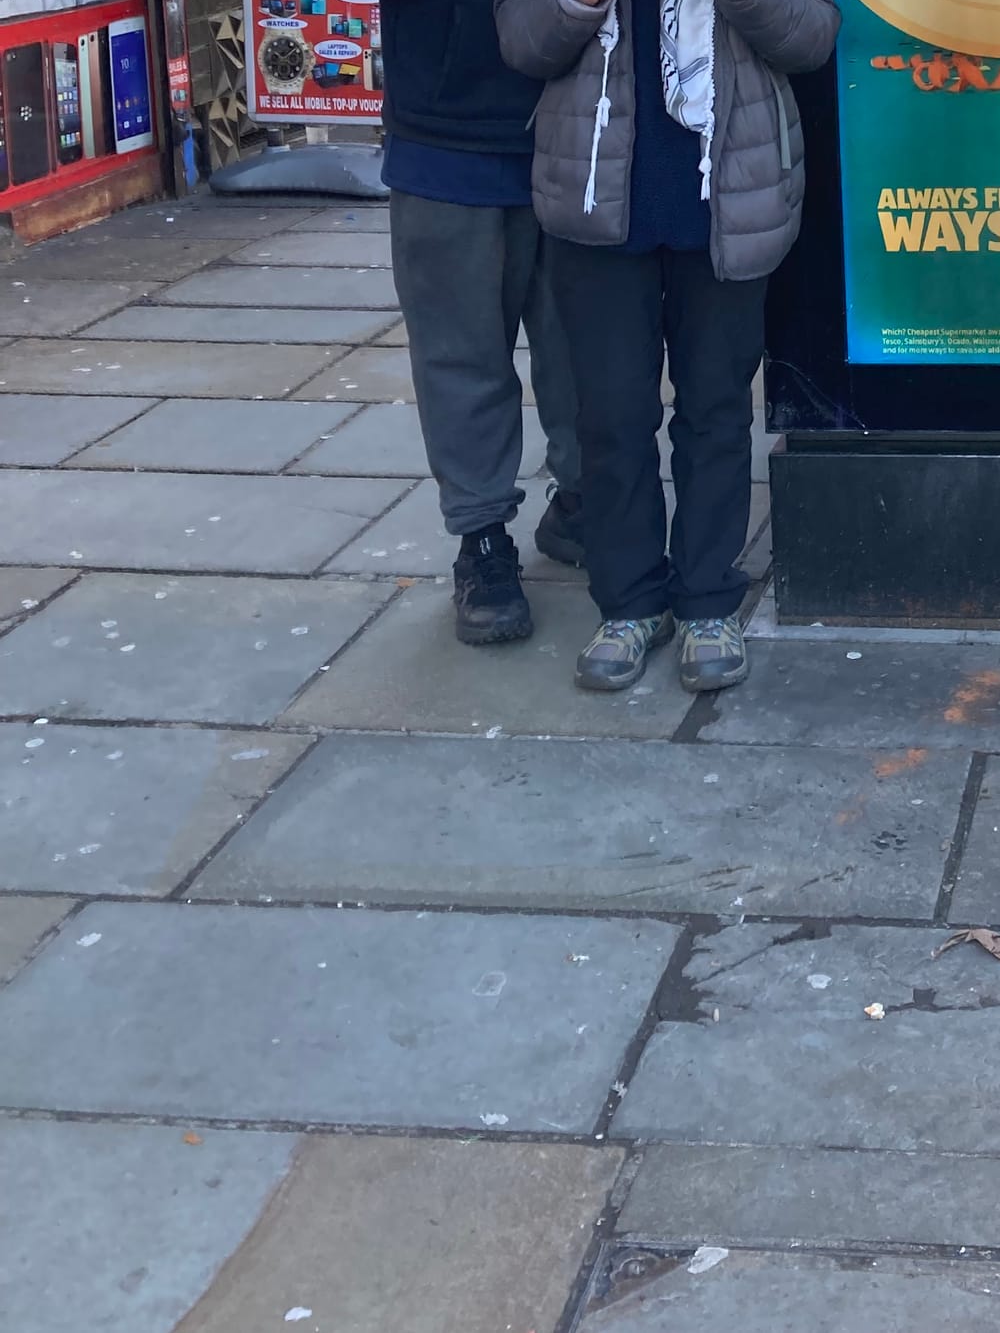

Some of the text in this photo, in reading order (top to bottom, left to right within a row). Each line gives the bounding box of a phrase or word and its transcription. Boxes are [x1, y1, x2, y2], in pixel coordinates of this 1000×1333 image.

[265, 20, 300, 28] WATCHES
[259, 95, 271, 109] WE
[271, 96, 289, 109] SELL
[290, 96, 304, 109] ALL
[304, 97, 332, 110] MOBILE
[332, 98, 358, 111] TOP-UP
[876, 186, 979, 210] ALWAYS
[881, 328, 906, 336] Which?
[907, 328, 940, 338] Cheapest
[941, 328, 987, 339] Supermarket
[882, 337, 904, 346] Tesco,
[882, 347, 897, 355] and
[897, 347, 908, 355] for
[928, 348, 948, 356] ways
